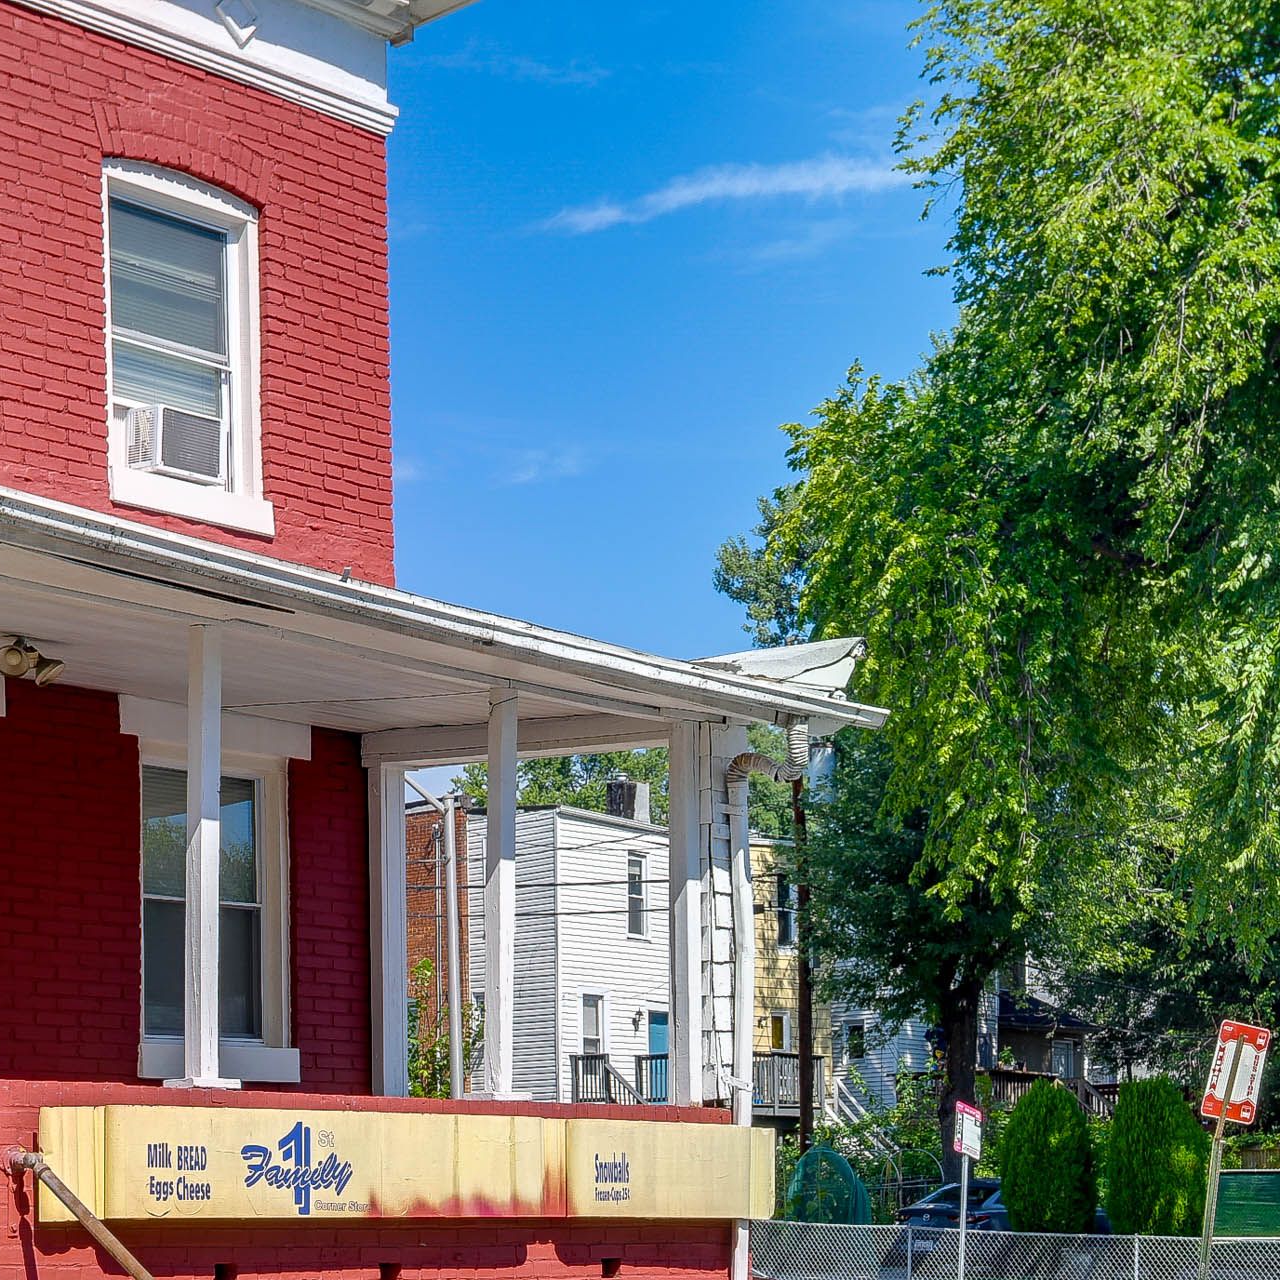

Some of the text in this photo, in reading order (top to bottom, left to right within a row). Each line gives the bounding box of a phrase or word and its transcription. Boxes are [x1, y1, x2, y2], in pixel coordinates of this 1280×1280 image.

[147, 1142, 207, 1171] Milk BREAD
[240, 1145, 353, 1196] Family
[595, 1152, 629, 1183] Snowballs
[149, 1175, 211, 1201] Eggs Cheese
[314, 1199, 347, 1212] Corner
